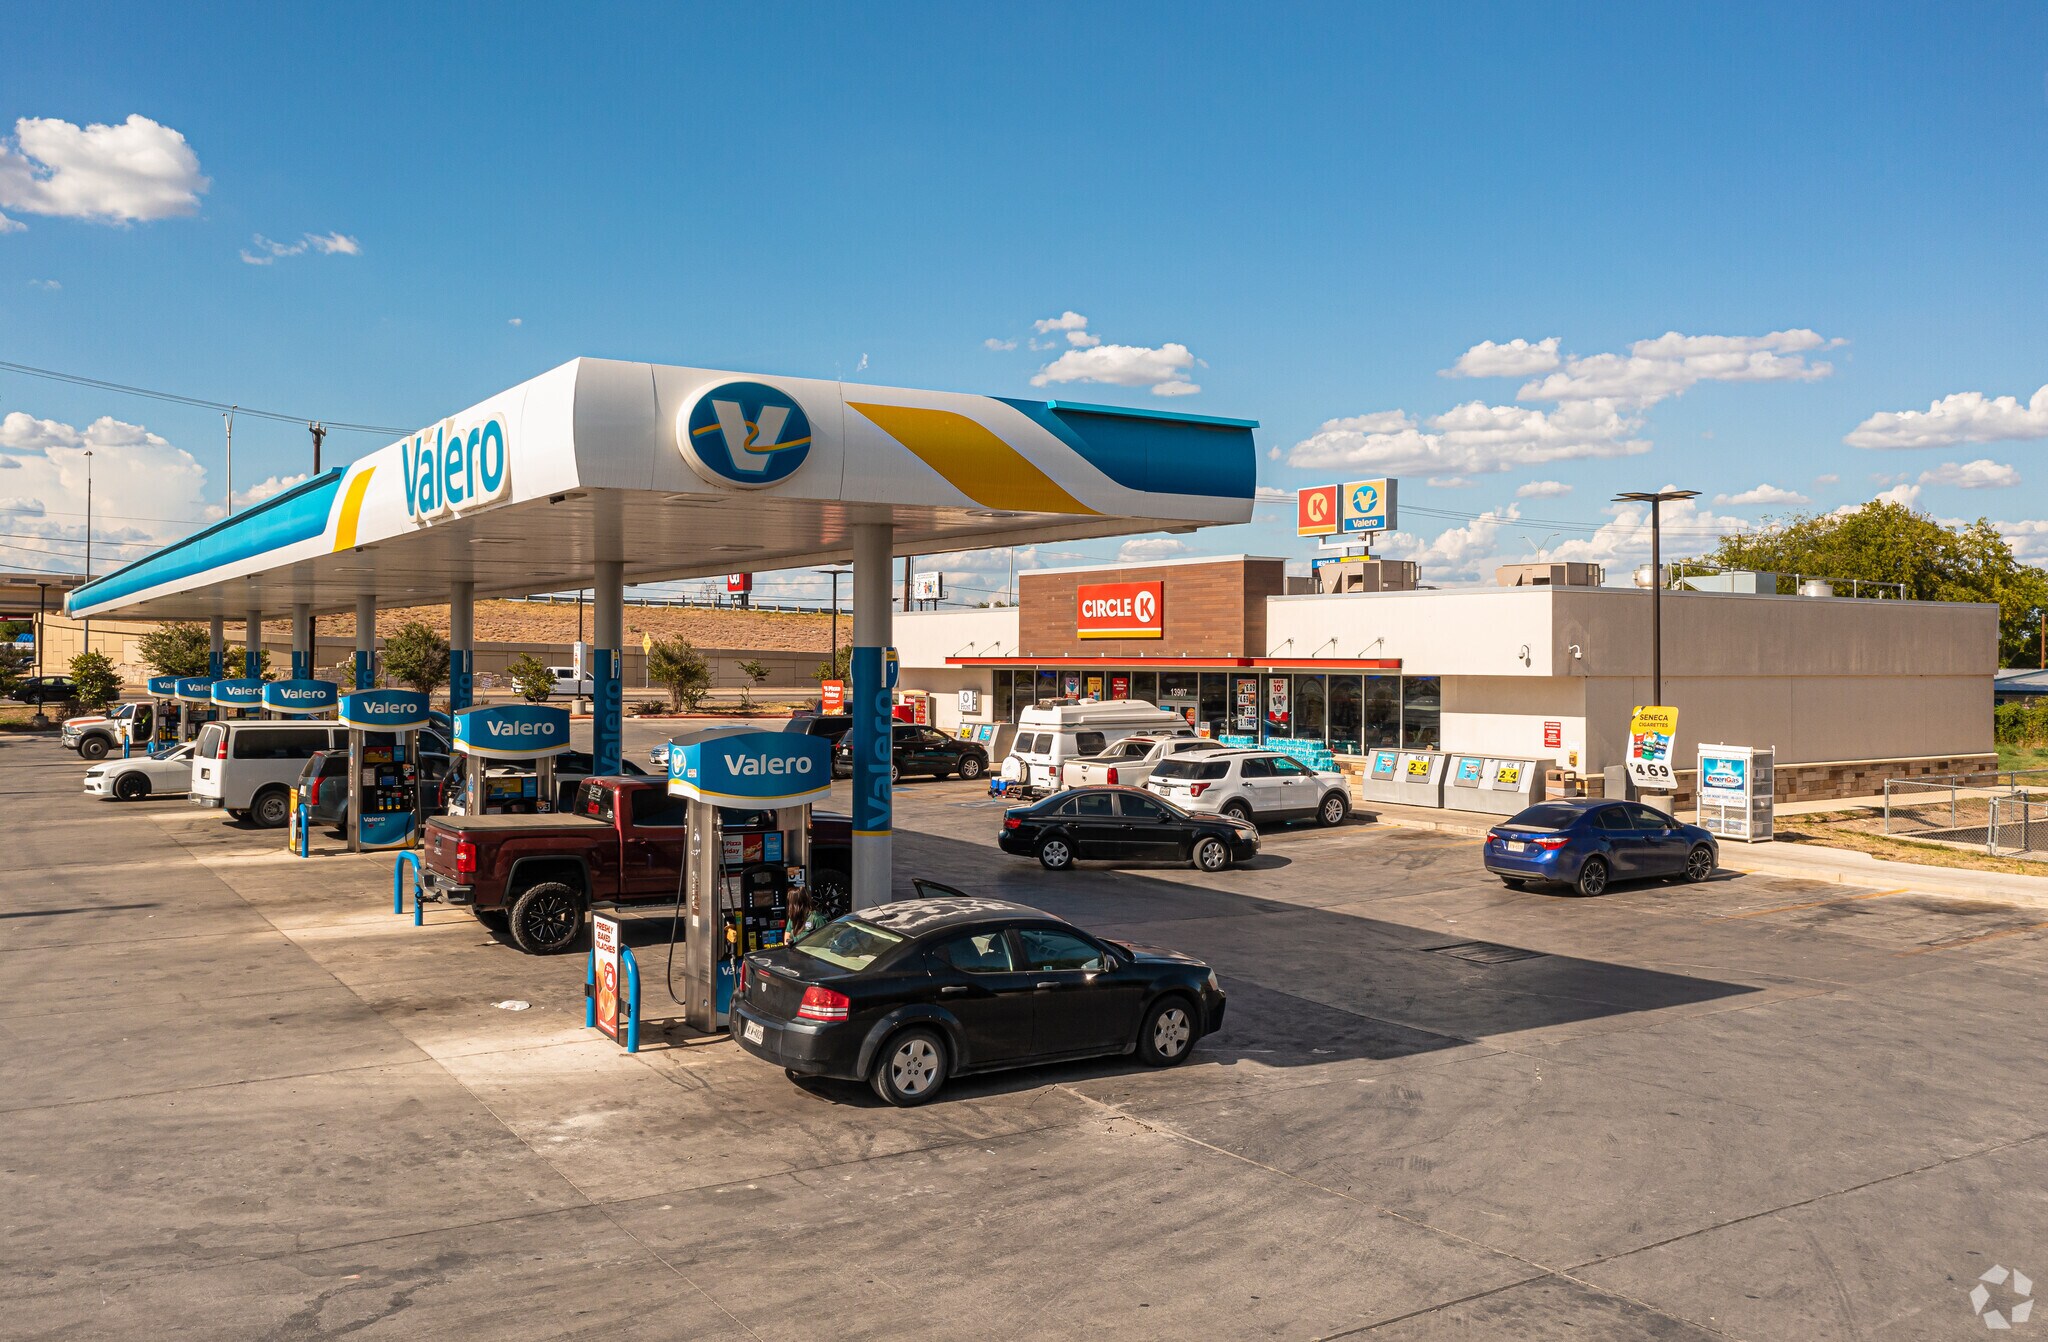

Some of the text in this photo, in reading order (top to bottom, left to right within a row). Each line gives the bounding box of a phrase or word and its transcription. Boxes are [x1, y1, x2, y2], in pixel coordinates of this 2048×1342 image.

[401, 419, 504, 516] Valero
[1312, 497, 1326, 521] K
[1352, 519, 1378, 528] Valero
[1082, 594, 1155, 622] CIRCLE K
[187, 683, 211, 692] Vale
[1170, 688, 1188, 697] 13907
[280, 688, 327, 699] Valero
[363, 701, 418, 714] Valero
[1639, 713, 1669, 721] SENECA
[486, 720, 555, 736] Valero
[867, 687, 892, 829] Valero
[723, 753, 812, 776] Valero
[1410, 763, 1417, 771] 2
[1499, 770, 1506, 778] 2
[1707, 775, 1740, 784] AmeriGas
[596, 921, 613, 934] FRESHLY
[597, 931, 610, 943] BAKED
[721, 966, 742, 976] Vale
